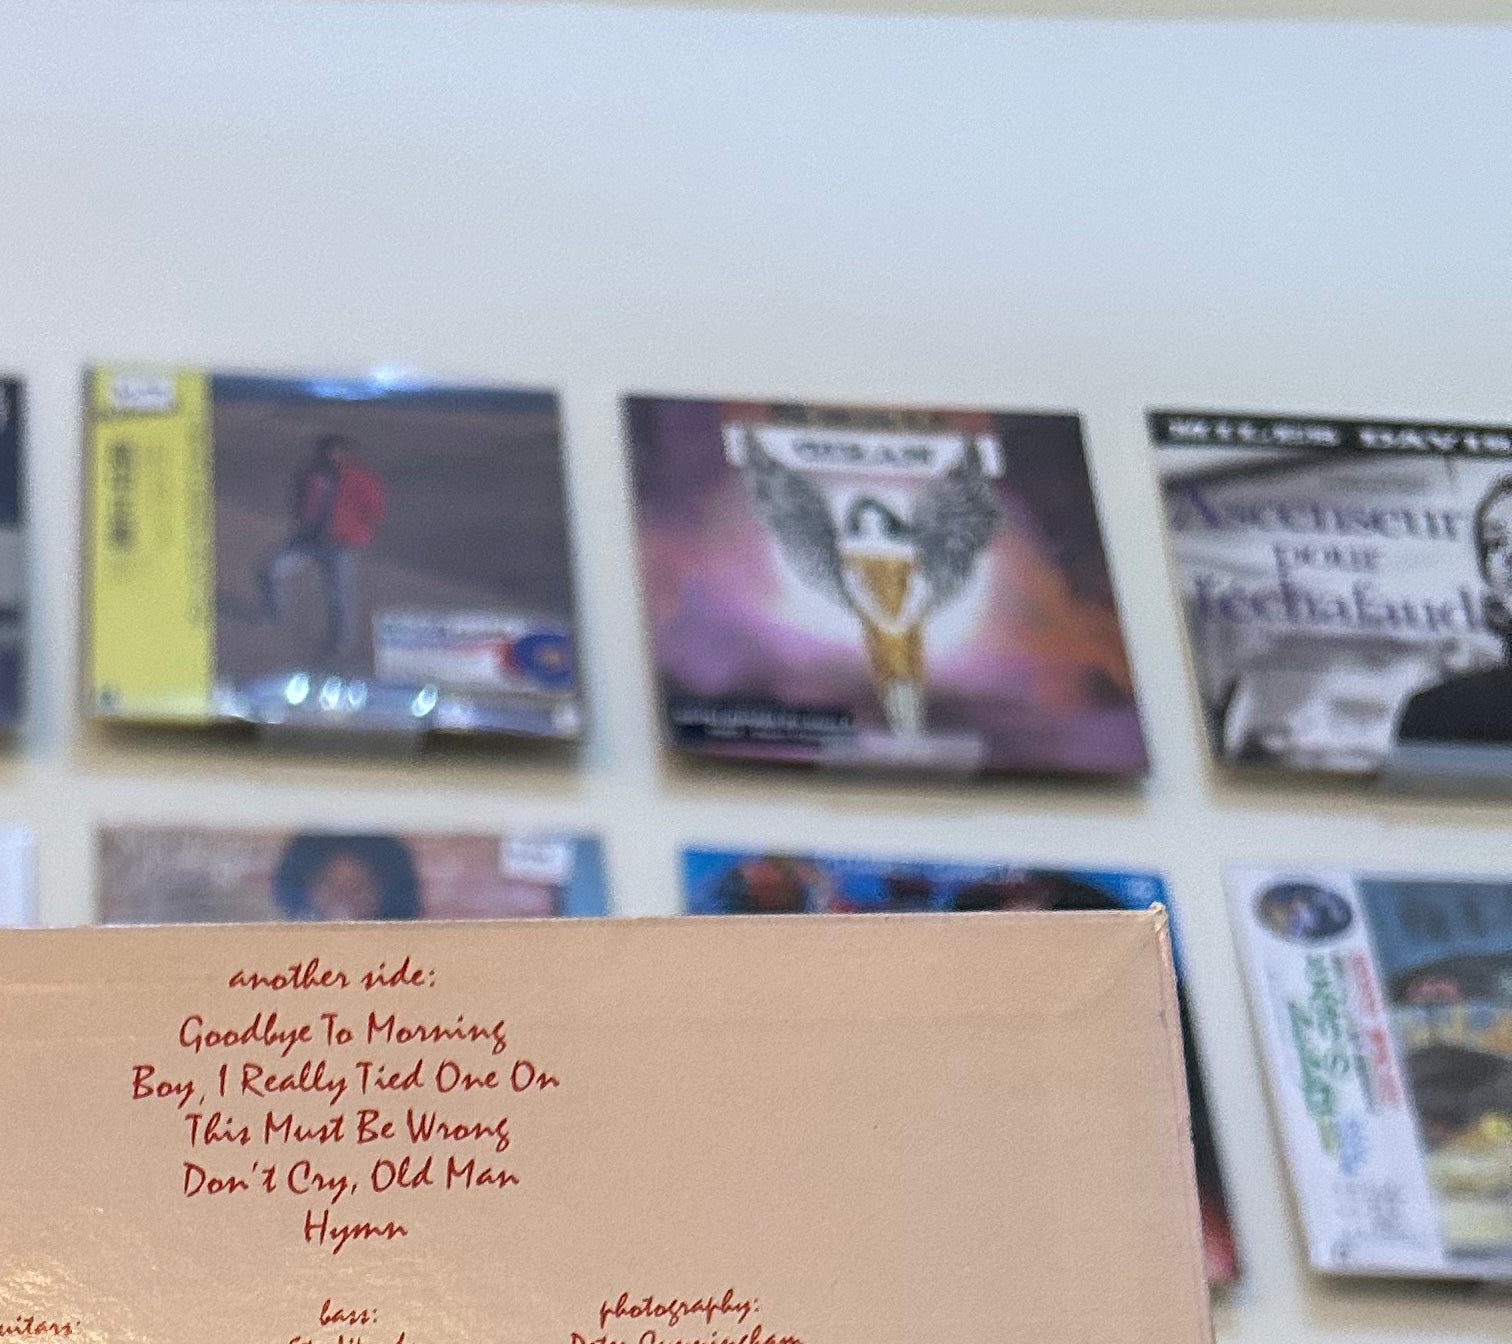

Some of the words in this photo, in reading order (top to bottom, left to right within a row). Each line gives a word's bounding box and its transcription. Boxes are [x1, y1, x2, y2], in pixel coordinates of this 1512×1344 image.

[1168, 419, 1338, 444] MILES
[1358, 427, 1512, 452] DAVIS
[228, 956, 347, 991] another
[361, 956, 435, 990] side:
[179, 1012, 312, 1057] Goodbye
[321, 1012, 353, 1045] To
[367, 1011, 506, 1054] Morning
[132, 1064, 205, 1109] Boy,
[219, 1064, 226, 1095] I
[242, 1060, 347, 1105] Really
[356, 1058, 424, 1093] Tied
[435, 1060, 499, 1093] One
[510, 1060, 560, 1092] On
[186, 1112, 250, 1147] This
[265, 1112, 345, 1145] Must
[357, 1110, 394, 1144] Be
[406, 1108, 510, 1153] Wrong
[183, 1161, 276, 1198] Don't
[288, 1160, 356, 1202] Cry,
[371, 1156, 433, 1192] Old
[446, 1156, 520, 1189] Man
[304, 1210, 408, 1255] Hymn
[319, 1299, 378, 1326] bass:
[599, 1288, 760, 1327] photography:
